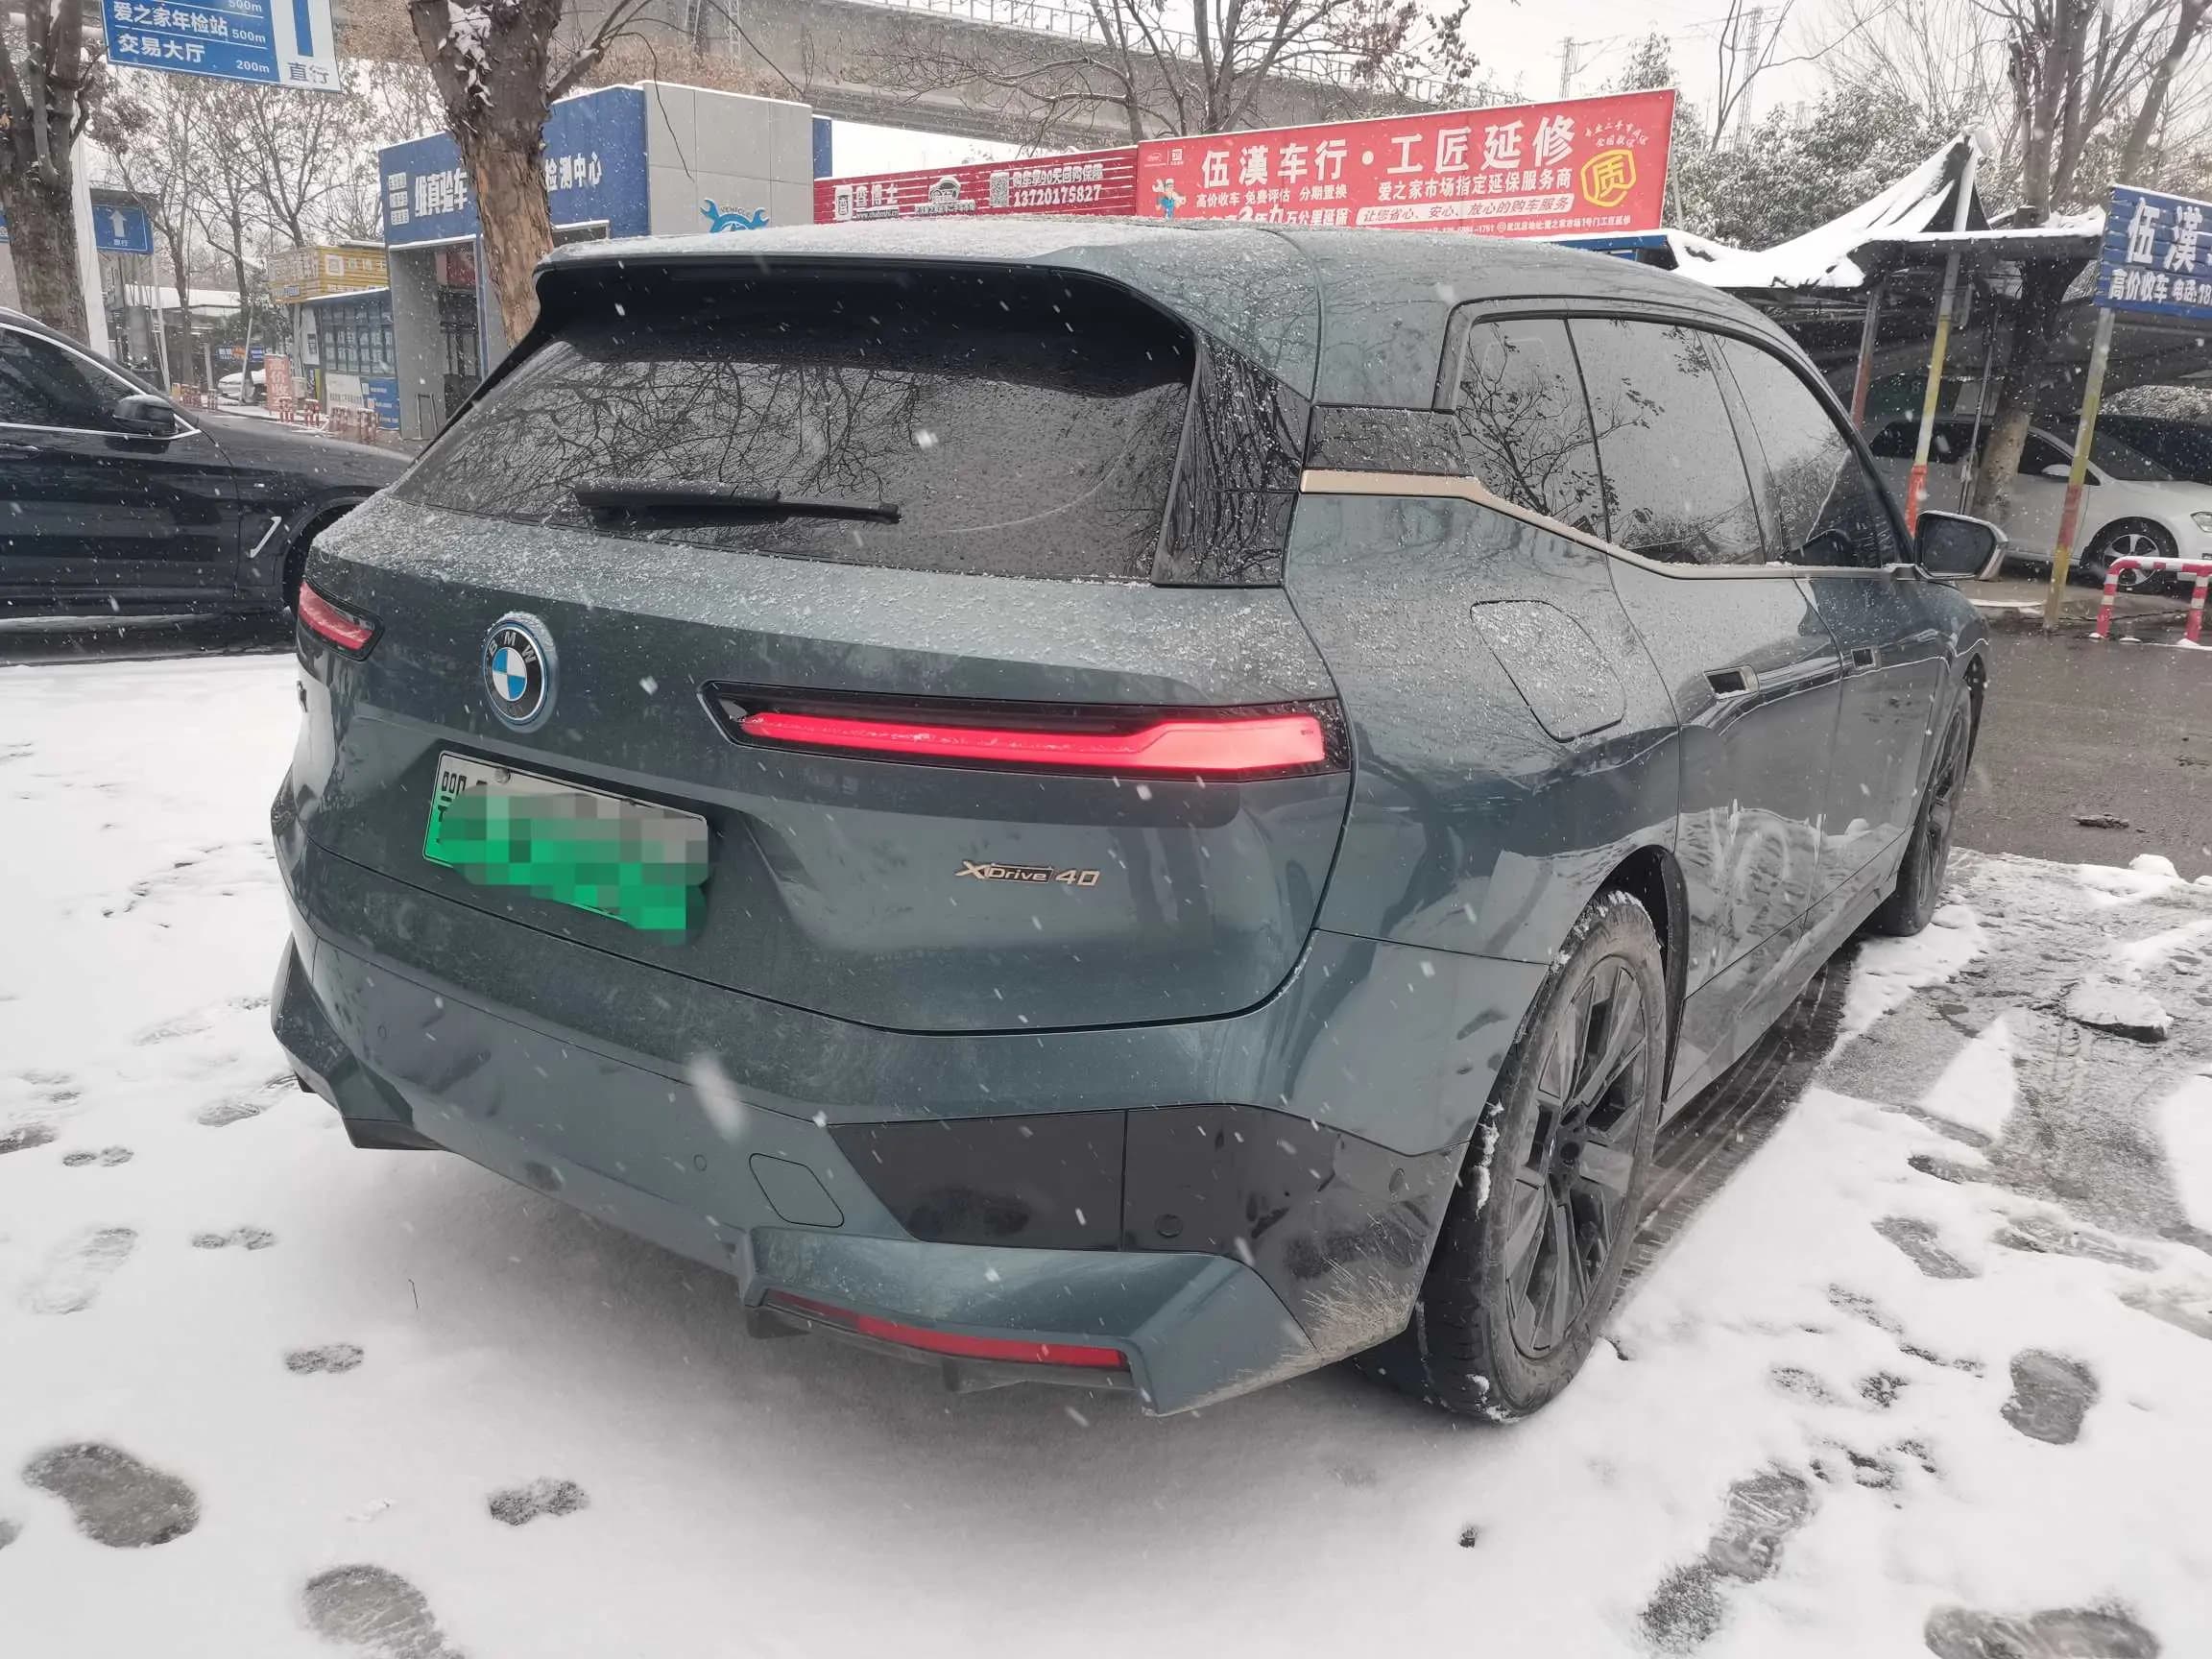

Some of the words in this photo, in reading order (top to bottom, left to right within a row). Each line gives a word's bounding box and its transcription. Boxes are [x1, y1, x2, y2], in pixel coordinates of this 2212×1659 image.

[113, 1, 228, 37] 爱之家年检站
[231, 29, 267, 43] 500m
[117, 34, 205, 62] 交易大厅
[236, 60, 270, 73] 200m
[287, 61, 329, 84] 直行
[1196, 192, 1241, 208] 高价收车
[1244, 188, 1291, 204] 免费评估
[1299, 183, 1348, 201] 分期置换
[1378, 167, 1573, 202] 爱之家市场指定延保服务商
[2127, 197, 2212, 272] 伍漢
[2107, 269, 2170, 303] 高价收车
[488, 632, 537, 663] BMW
[1056, 870, 1100, 886] 40
